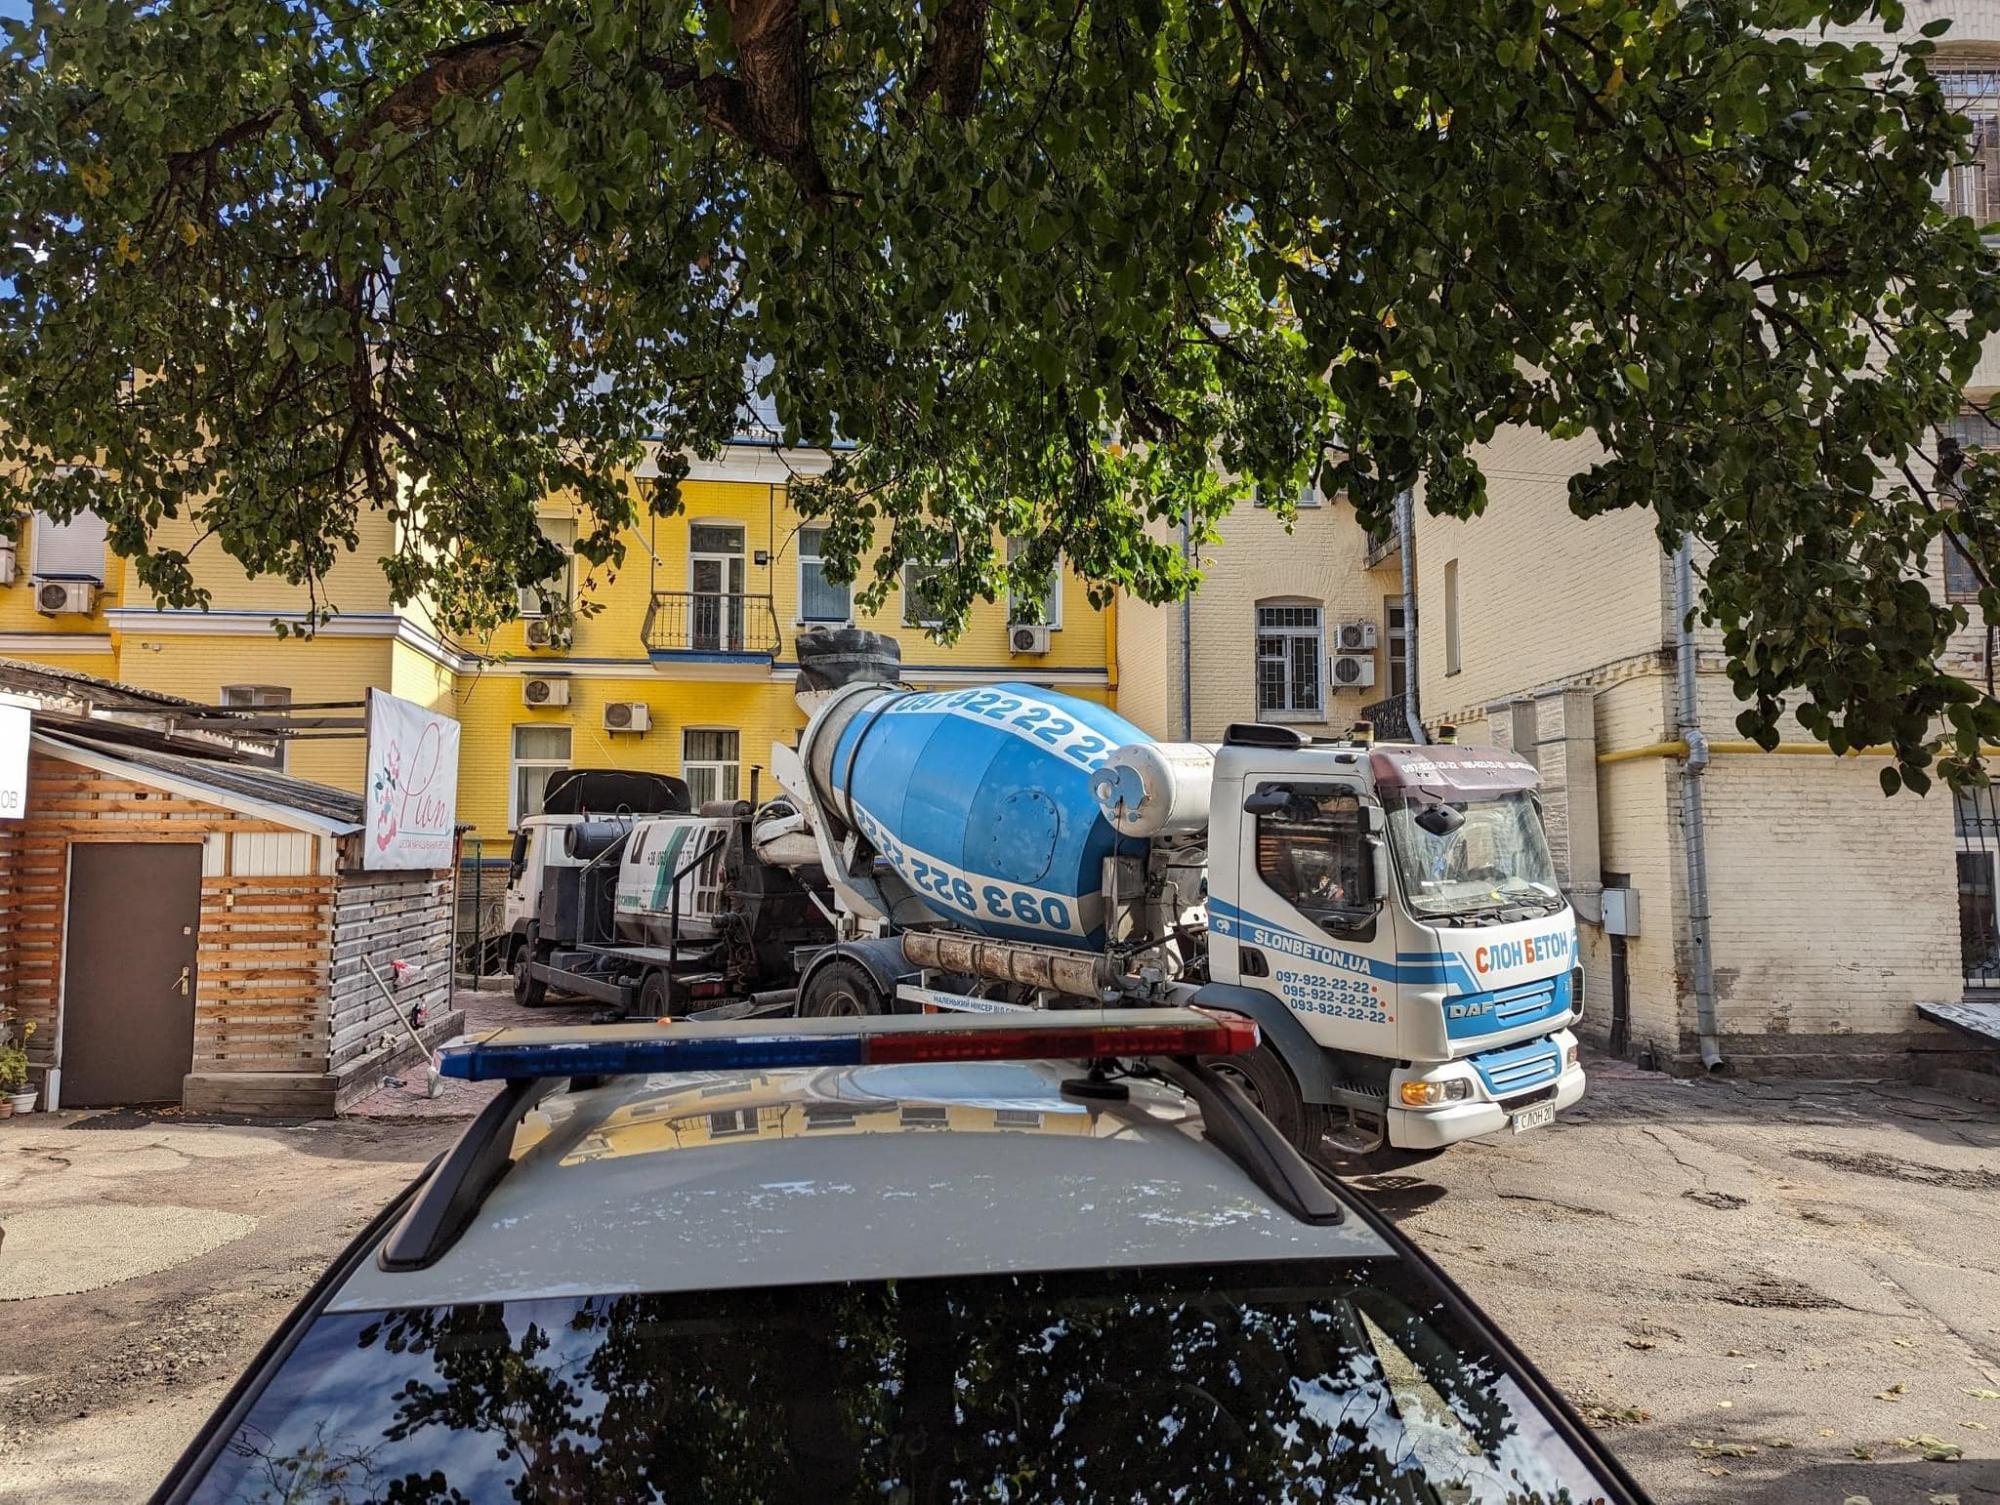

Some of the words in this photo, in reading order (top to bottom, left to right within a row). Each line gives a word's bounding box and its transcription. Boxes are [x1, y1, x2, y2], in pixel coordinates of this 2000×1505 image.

[946, 690, 1021, 721] 922
[1011, 707, 1075, 745] 22
[1063, 735, 1117, 769] 2
[910, 857, 977, 911] 922
[982, 885, 1071, 931] 093
[1253, 929, 1372, 975] SLONBETON.UA
[1475, 941, 1523, 974] СЛОН
[1524, 931, 1569, 964] БЕТОН
[1275, 970, 1370, 994] 097-922-22-22
[1282, 984, 1378, 1009] 095-922-22-22
[1290, 998, 1386, 1024] 093-922-22-22
[1449, 1001, 1495, 1019] DAF
